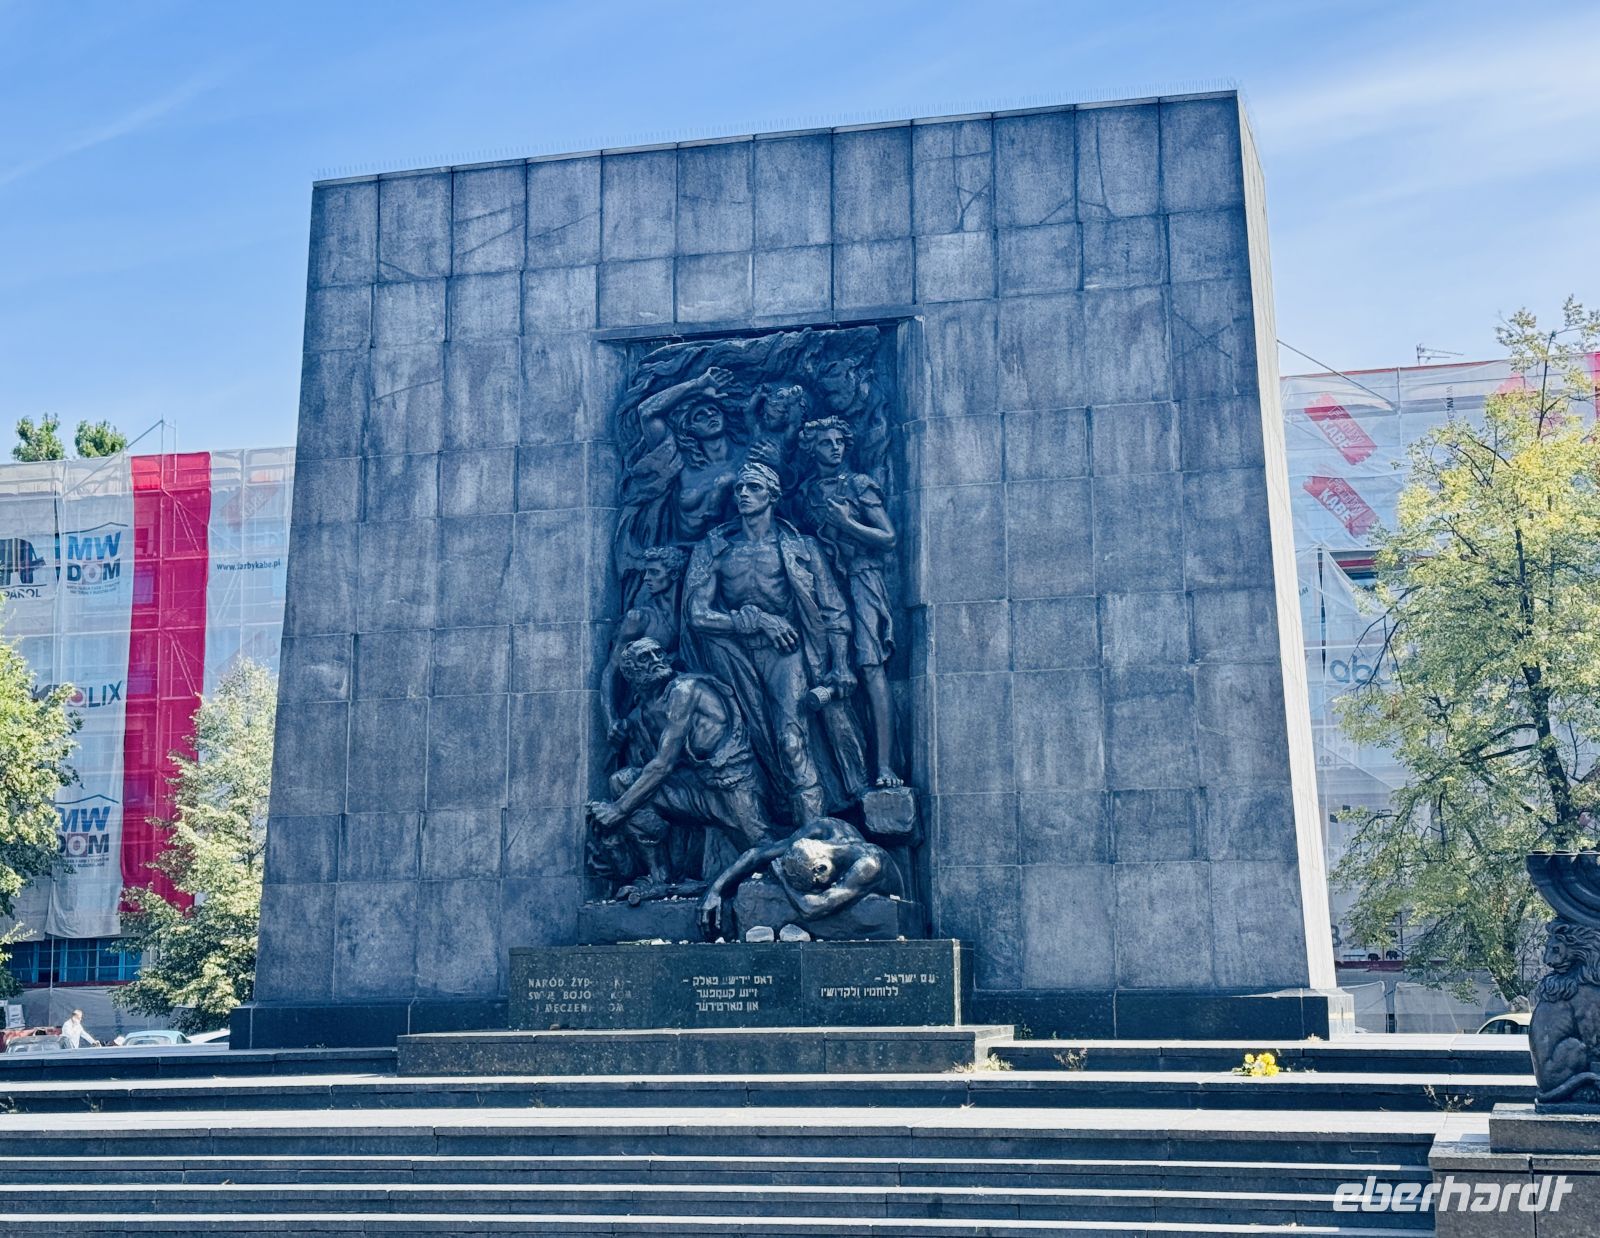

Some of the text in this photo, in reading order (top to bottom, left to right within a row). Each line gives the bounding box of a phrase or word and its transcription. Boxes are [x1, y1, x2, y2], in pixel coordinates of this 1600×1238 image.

[1319, 487, 1352, 522] KABE
[67, 530, 122, 560] MW
[66, 560, 121, 585] DOM
[528, 977, 564, 989] NARÓD
[884, 973, 917, 983] ישראל
